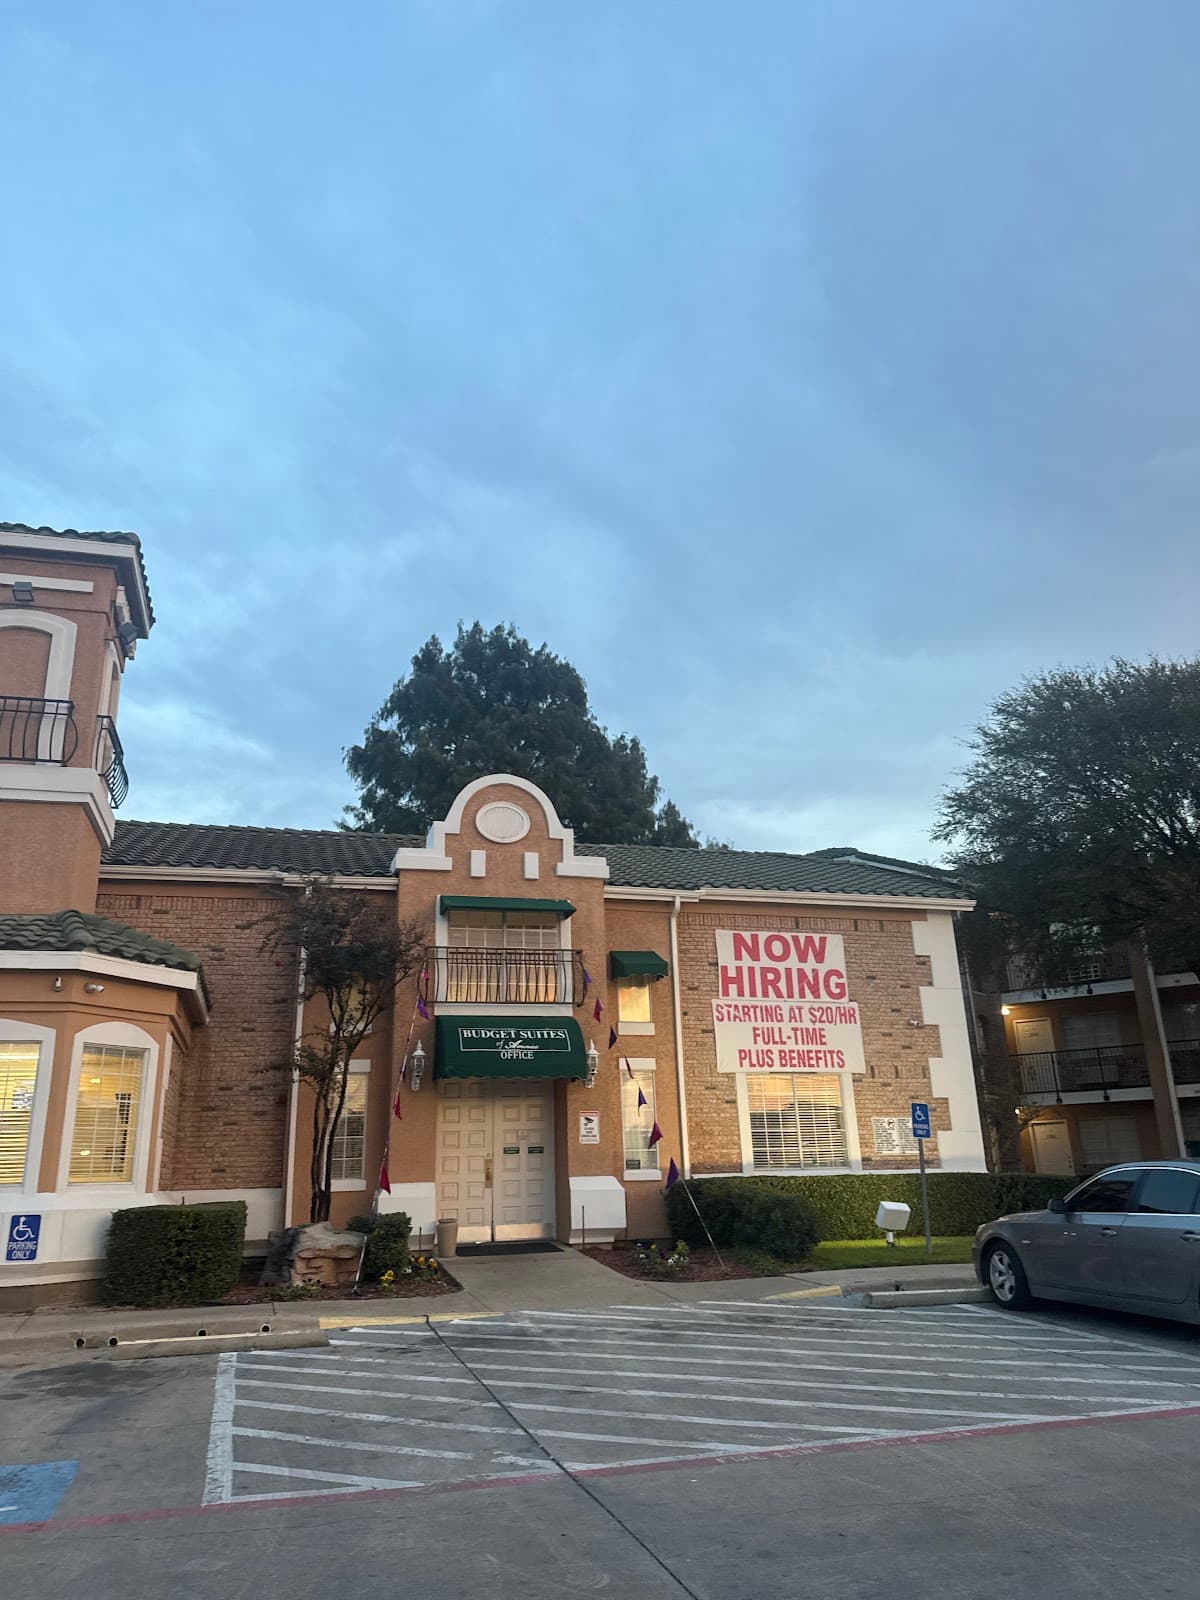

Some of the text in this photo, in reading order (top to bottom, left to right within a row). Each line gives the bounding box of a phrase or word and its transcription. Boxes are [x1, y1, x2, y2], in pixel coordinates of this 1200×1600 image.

[732, 933, 828, 964] NOW
[720, 965, 847, 1000] HIRING
[715, 1003, 858, 1026] STARTING AT $20/HR
[463, 1029, 566, 1039] BUDGET SUITES
[752, 1026, 827, 1046] FULL-TIME
[500, 1051, 535, 1060] OFFICE
[738, 1048, 846, 1069] PLUS BENEFITS
[11, 1250, 32, 1260] ONLY
